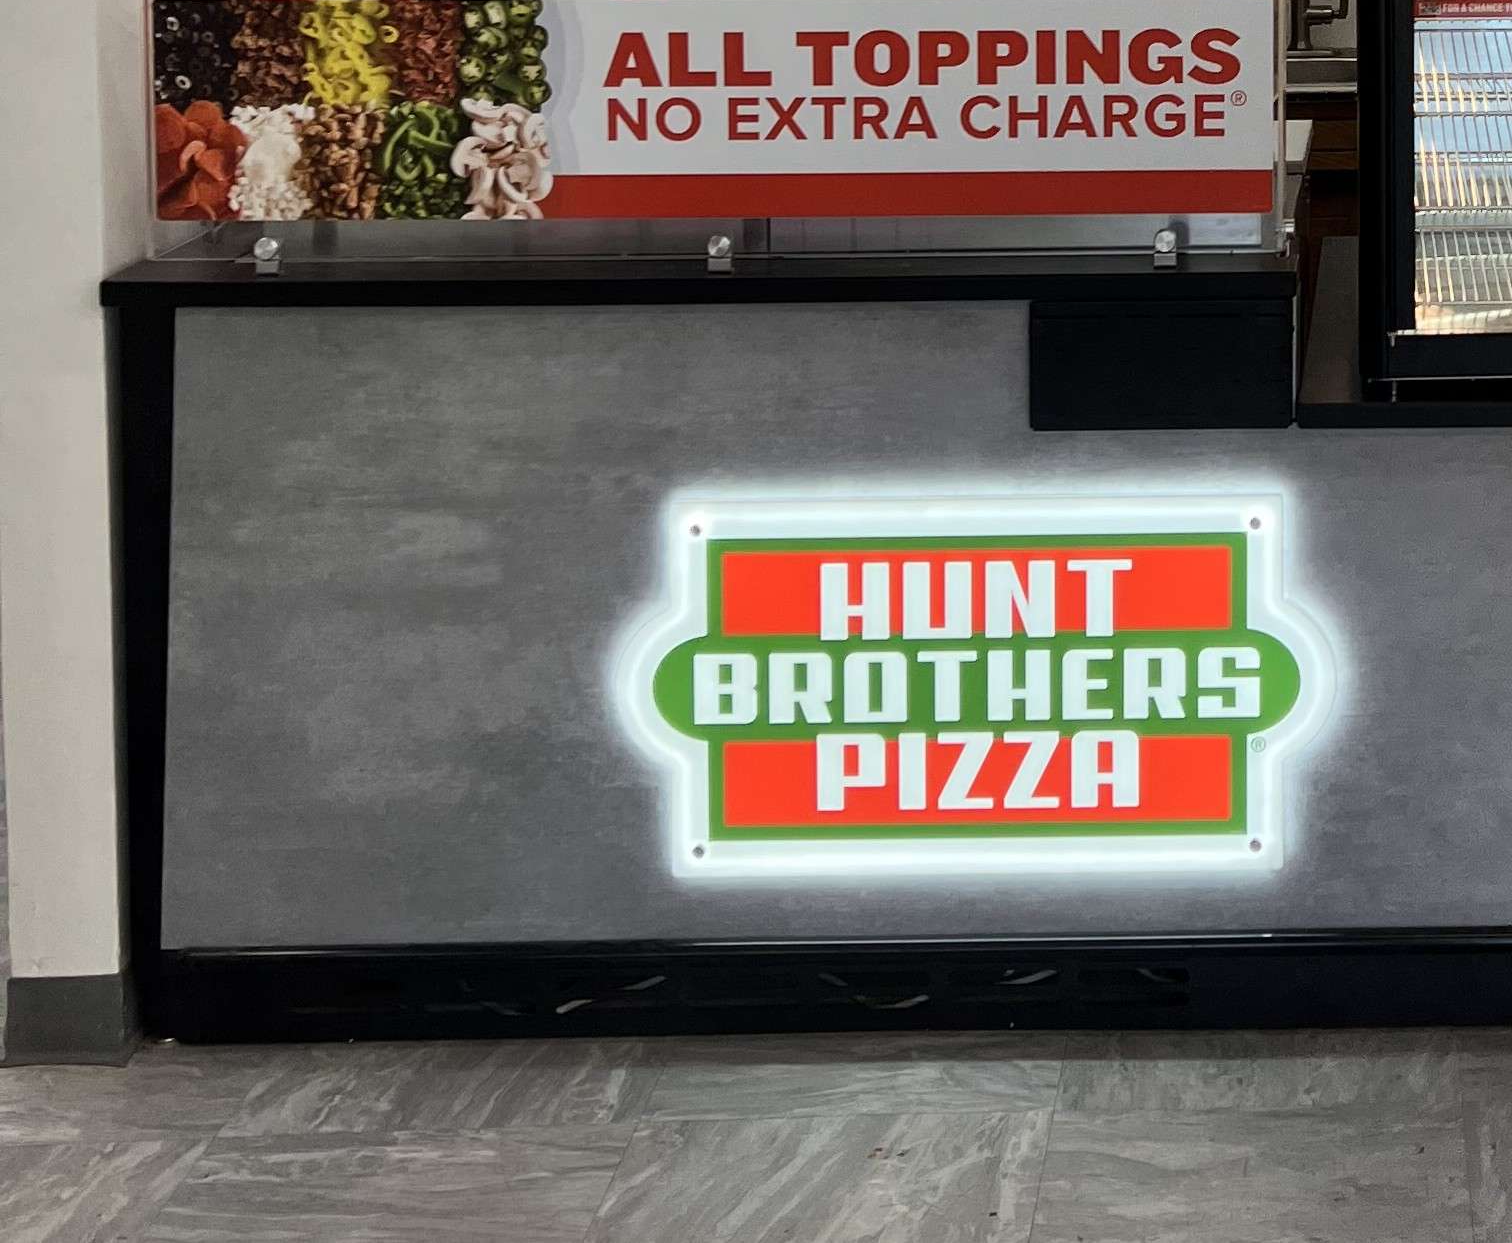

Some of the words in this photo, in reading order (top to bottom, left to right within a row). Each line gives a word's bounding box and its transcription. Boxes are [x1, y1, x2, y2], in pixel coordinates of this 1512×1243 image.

[602, 31, 773, 88] ALL
[796, 28, 1242, 87] TOPPINGS
[607, 97, 701, 142] NO
[727, 96, 938, 141] EXTRA
[818, 558, 1133, 642] HUNT
[692, 646, 1262, 726] BROTHERS
[815, 730, 1141, 812] PIZZA
